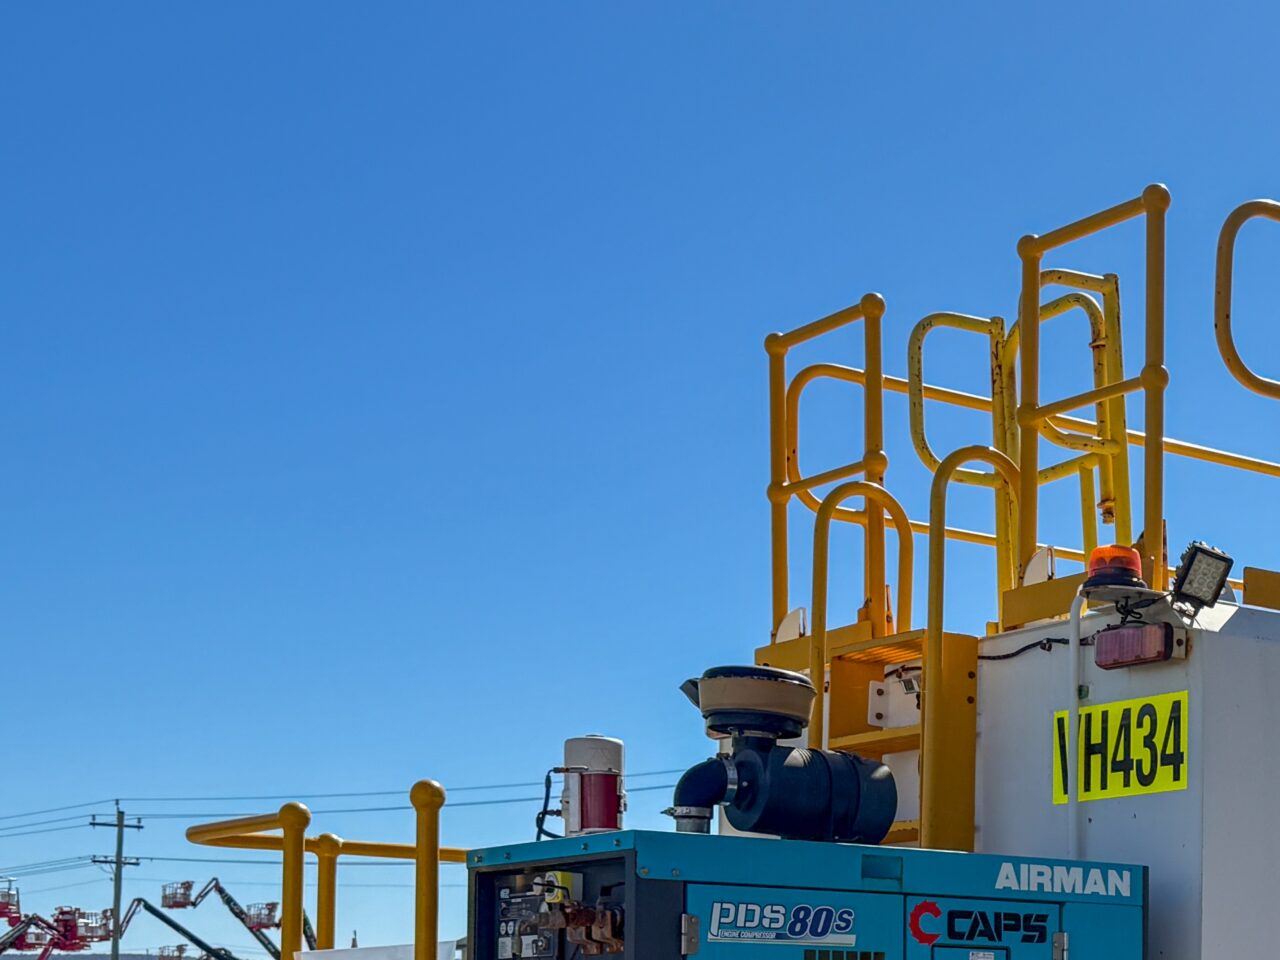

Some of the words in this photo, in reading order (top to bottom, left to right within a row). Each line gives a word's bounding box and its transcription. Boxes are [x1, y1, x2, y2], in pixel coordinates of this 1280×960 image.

[1057, 700, 1184, 796] VH434
[995, 863, 1131, 897] AIRMAN
[947, 910, 1049, 943] CAPS
